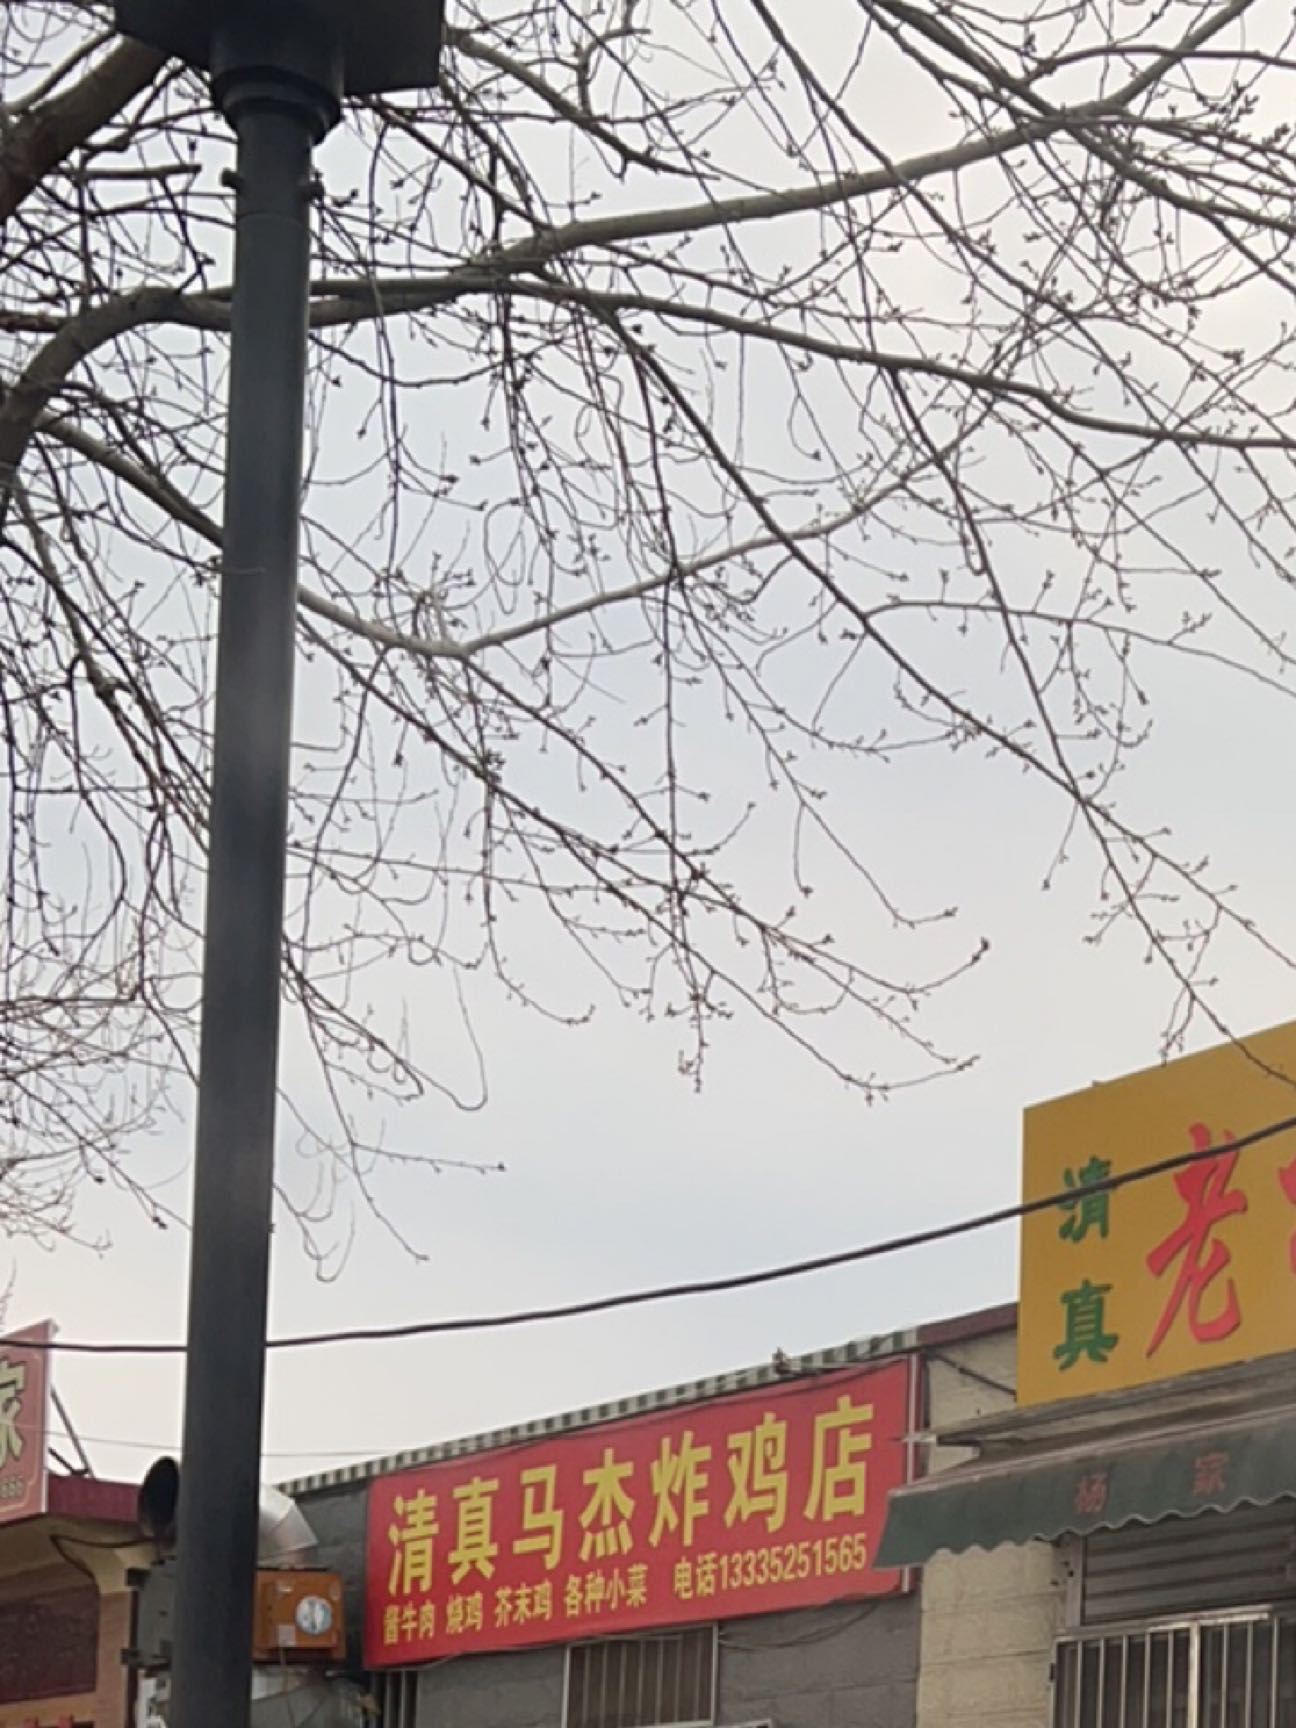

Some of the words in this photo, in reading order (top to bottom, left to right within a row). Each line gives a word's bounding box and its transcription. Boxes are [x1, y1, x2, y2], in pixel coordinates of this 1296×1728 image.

[1053, 1155, 1119, 1371] 清真
[387, 1394, 874, 1597] 清真马杰炸鸡店
[563, 1562, 649, 1619] 各种小菜
